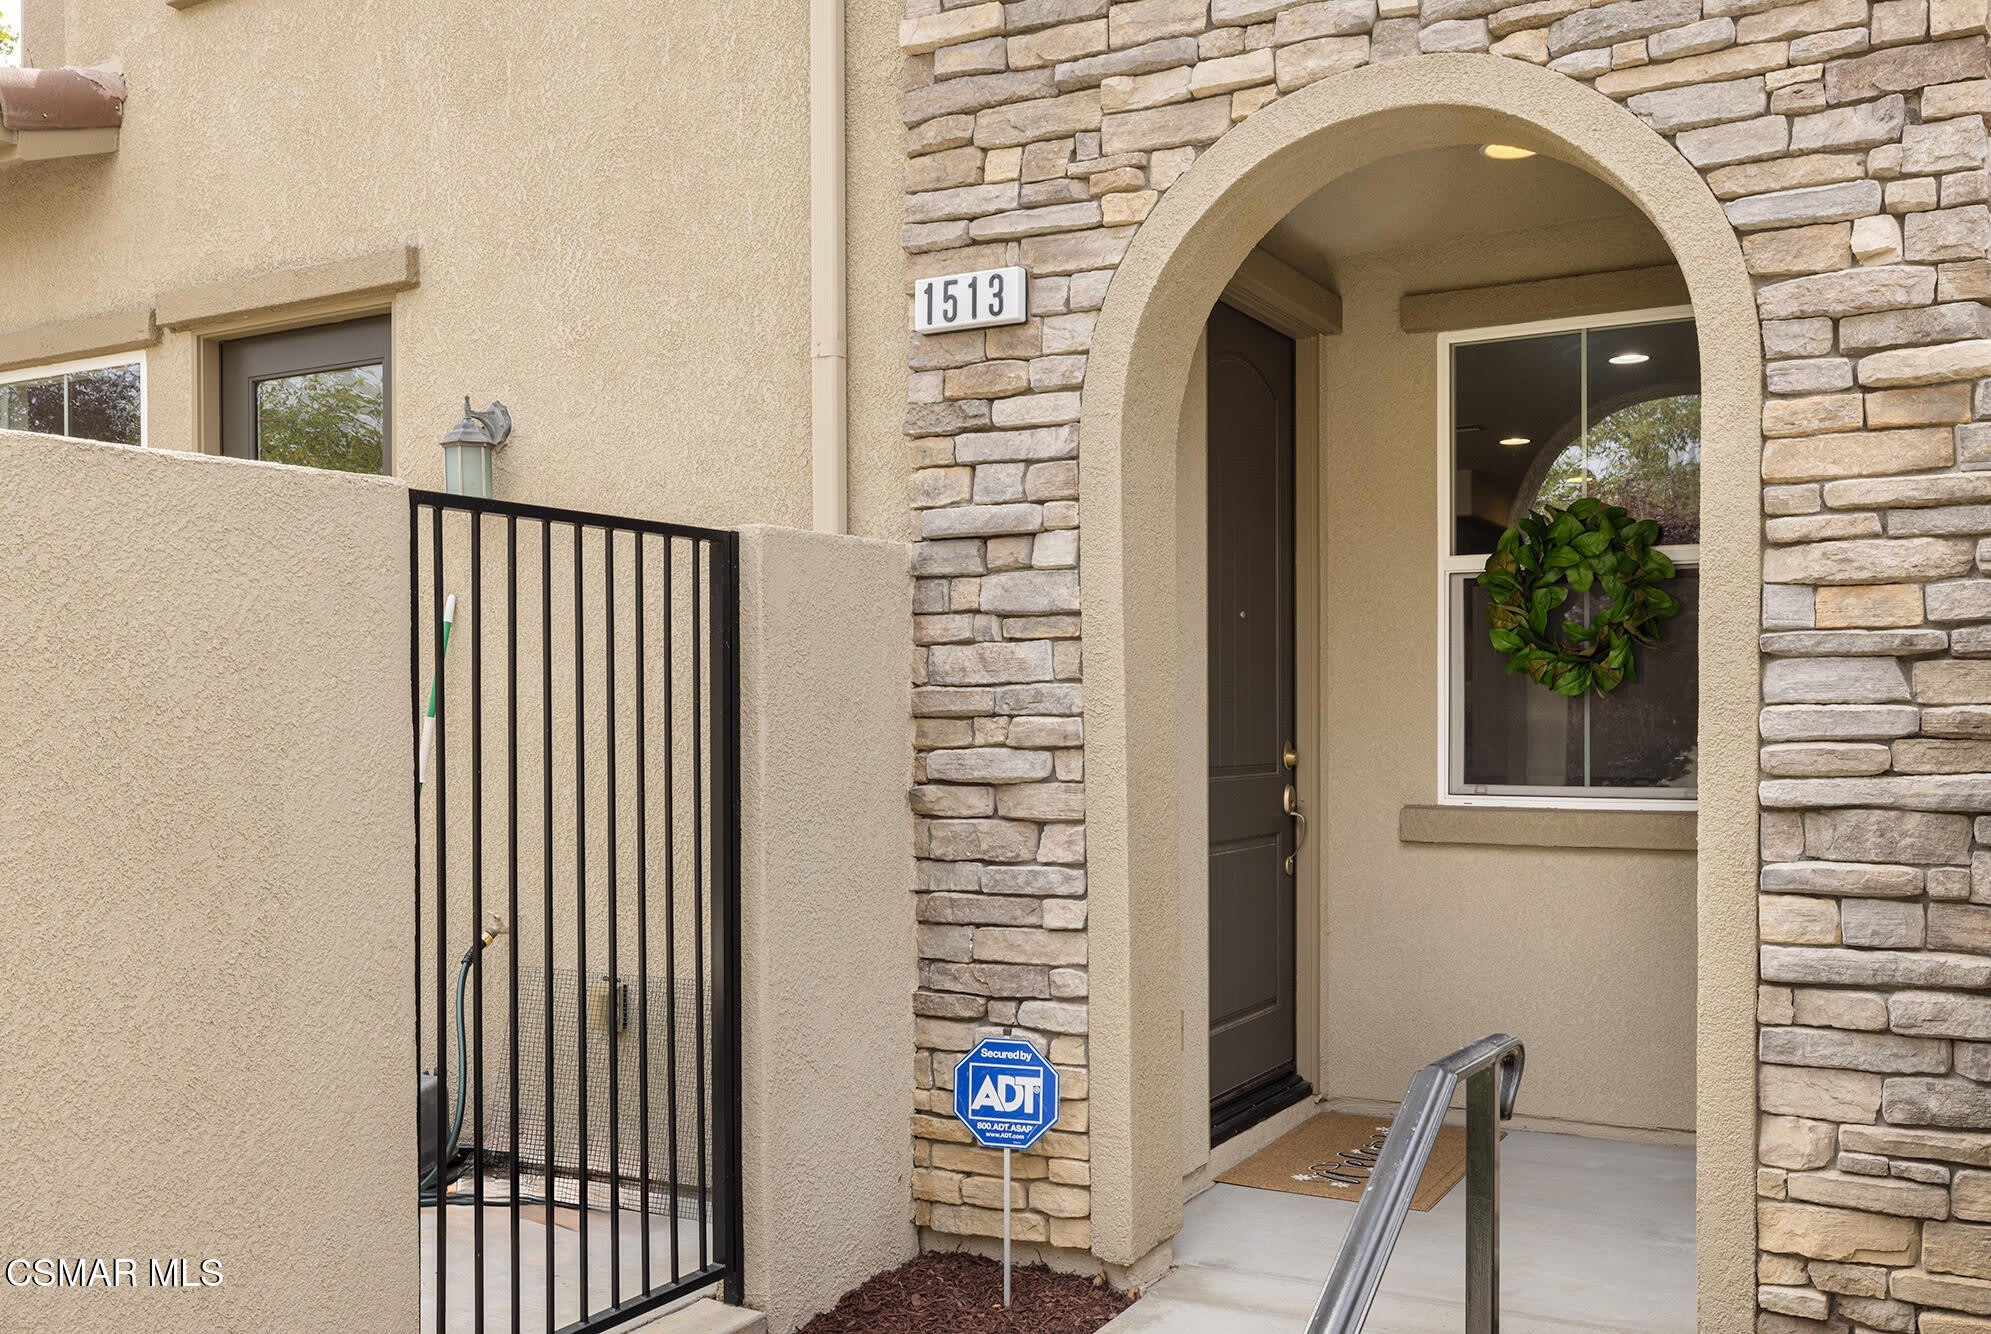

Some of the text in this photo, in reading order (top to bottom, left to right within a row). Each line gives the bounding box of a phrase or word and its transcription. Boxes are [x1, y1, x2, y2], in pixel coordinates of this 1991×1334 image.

[924, 273, 1004, 325] 1513
[981, 1048, 1032, 1062] Secured by
[977, 1122, 1033, 1133] 800.ADT.ASAP
[986, 1132, 1025, 1140] www.ADT.com
